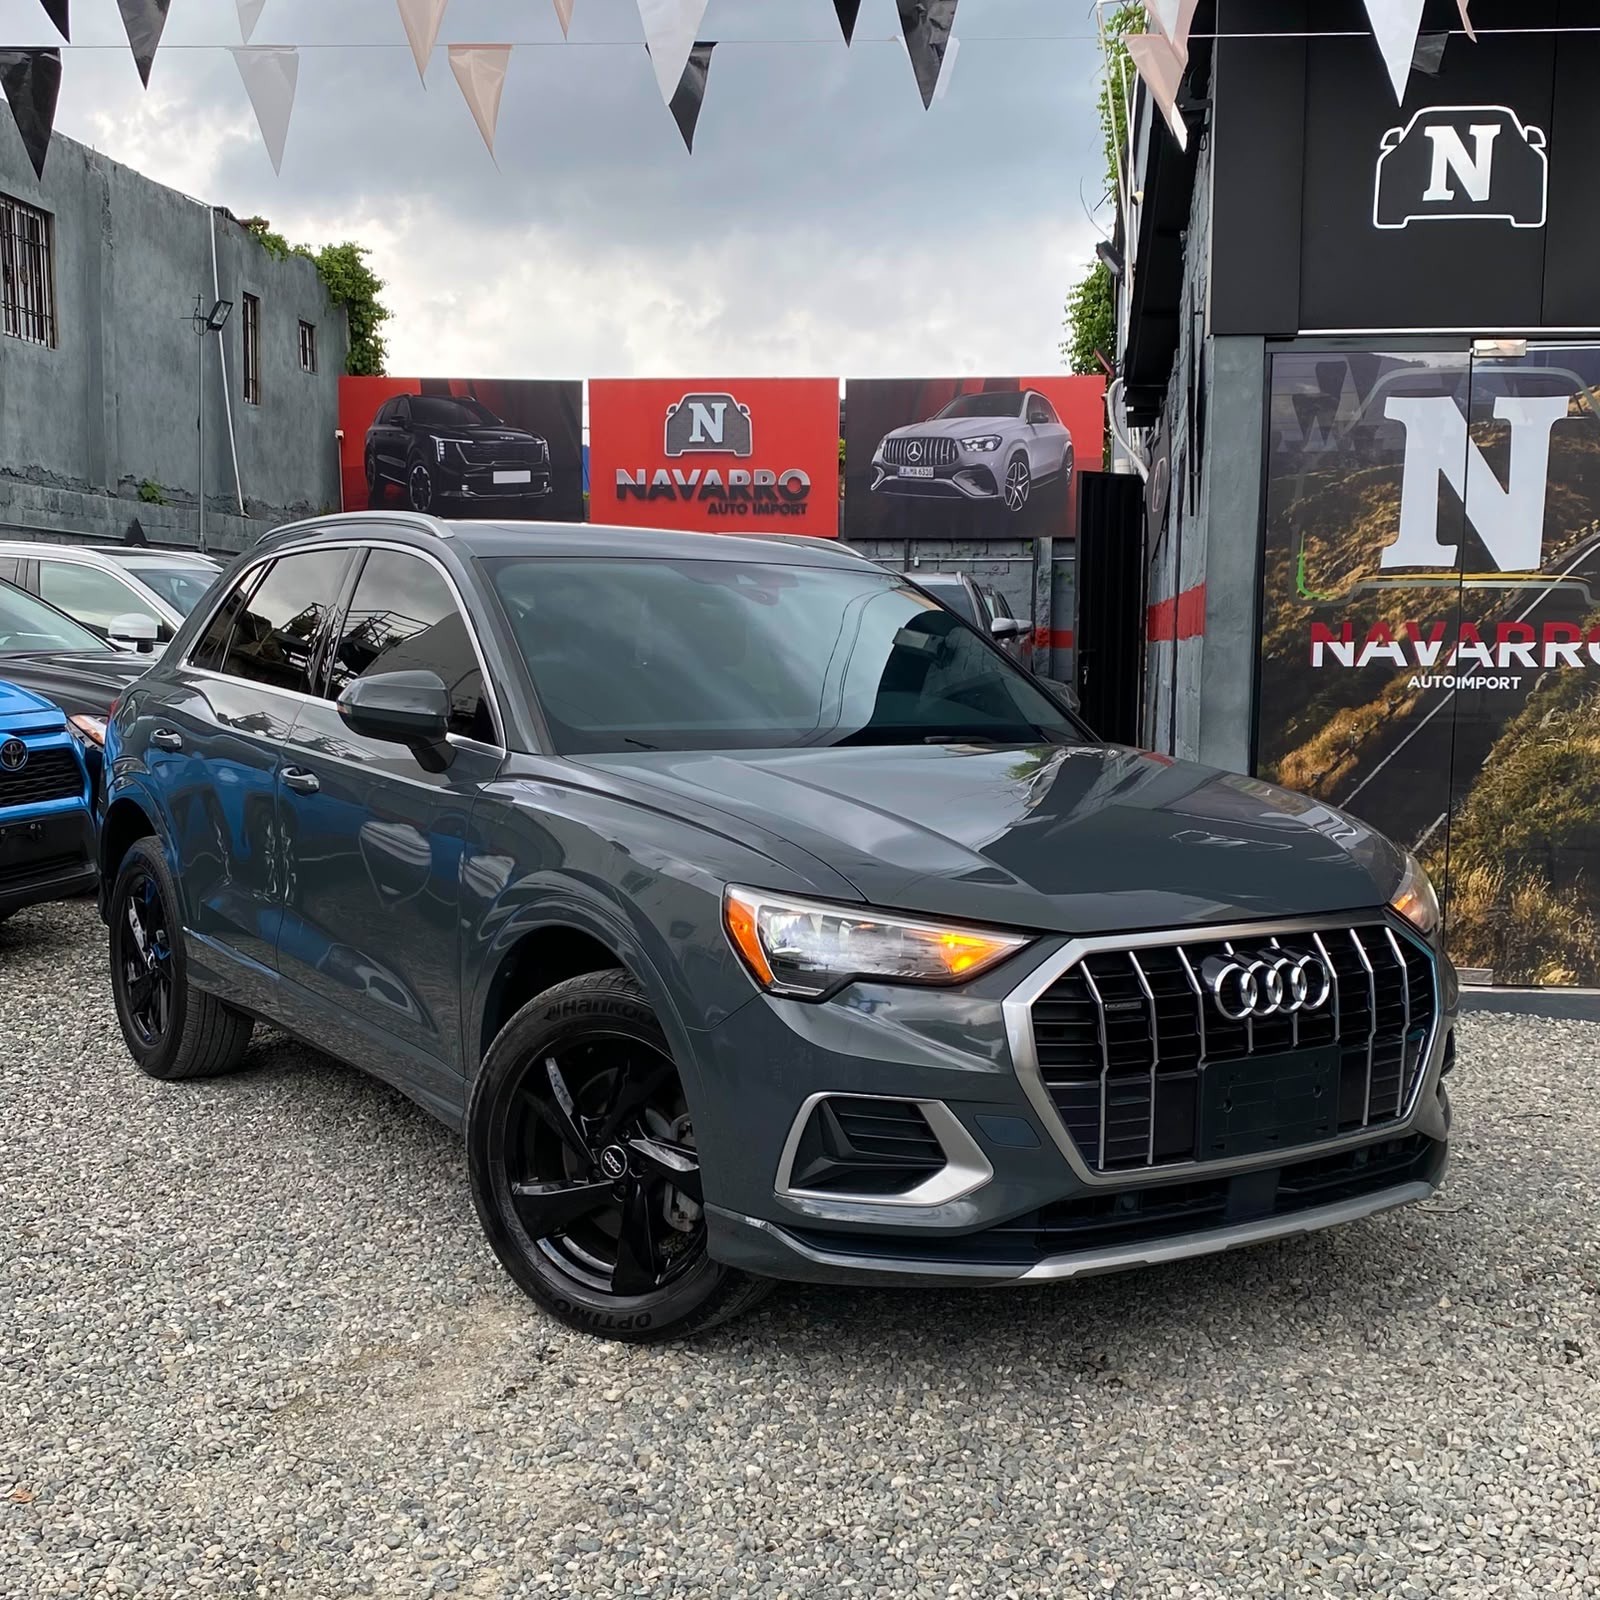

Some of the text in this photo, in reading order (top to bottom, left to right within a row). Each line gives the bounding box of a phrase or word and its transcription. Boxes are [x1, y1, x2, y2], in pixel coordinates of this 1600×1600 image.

[1422, 124, 1502, 202] N
[688, 402, 728, 443] N
[616, 468, 811, 502] NAVARRO
[1380, 395, 1570, 572] N
[707, 503, 808, 516] AUTO IMPORT
[1310, 621, 1600, 669] NAVARR
